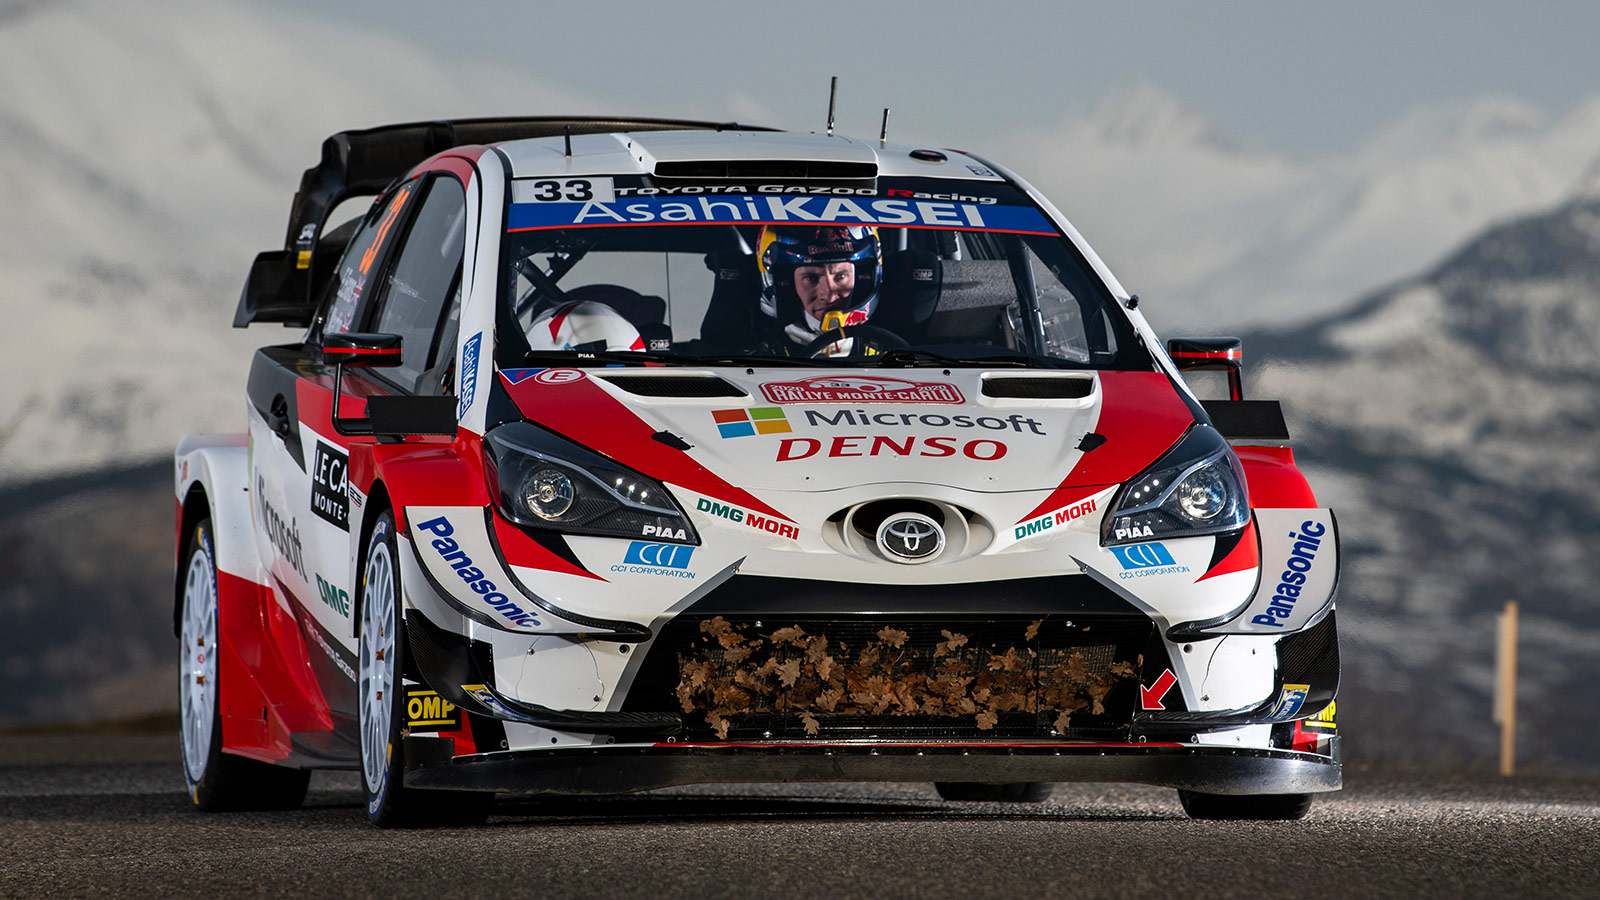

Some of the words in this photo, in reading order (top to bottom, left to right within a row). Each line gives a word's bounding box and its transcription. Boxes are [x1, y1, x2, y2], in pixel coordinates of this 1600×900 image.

[534, 180, 593, 202] 33
[614, 185, 748, 196] TOYOTA
[757, 184, 878, 195] GAZOO
[886, 189, 998, 205] Racing
[807, 245, 830, 255] Red
[832, 241, 854, 252] Bull
[650, 342, 670, 350] OMP
[549, 371, 574, 381] E
[772, 389, 833, 401] RALLYE
[803, 409, 1047, 436] Microsoft
[775, 435, 1008, 462] DENSO
[329, 458, 349, 498] CA
[696, 497, 744, 523] DMG
[745, 513, 800, 540] MORI
[1014, 517, 1053, 540] DMG
[1055, 499, 1097, 525] MORI
[642, 524, 687, 540] PIAA
[1115, 525, 1154, 540] PIAA
[638, 543, 679, 567] CCI
[1124, 544, 1163, 567] CCI
[416, 515, 542, 629] Panasonic
[610, 564, 628, 573] CCI
[629, 565, 696, 580] CORPORATION
[1118, 571, 1135, 580] CCI
[1134, 565, 1190, 578] CORPORATION
[1250, 520, 1326, 628] Panasonic
[315, 572, 350, 619] DMG
[407, 696, 456, 720] OMP
